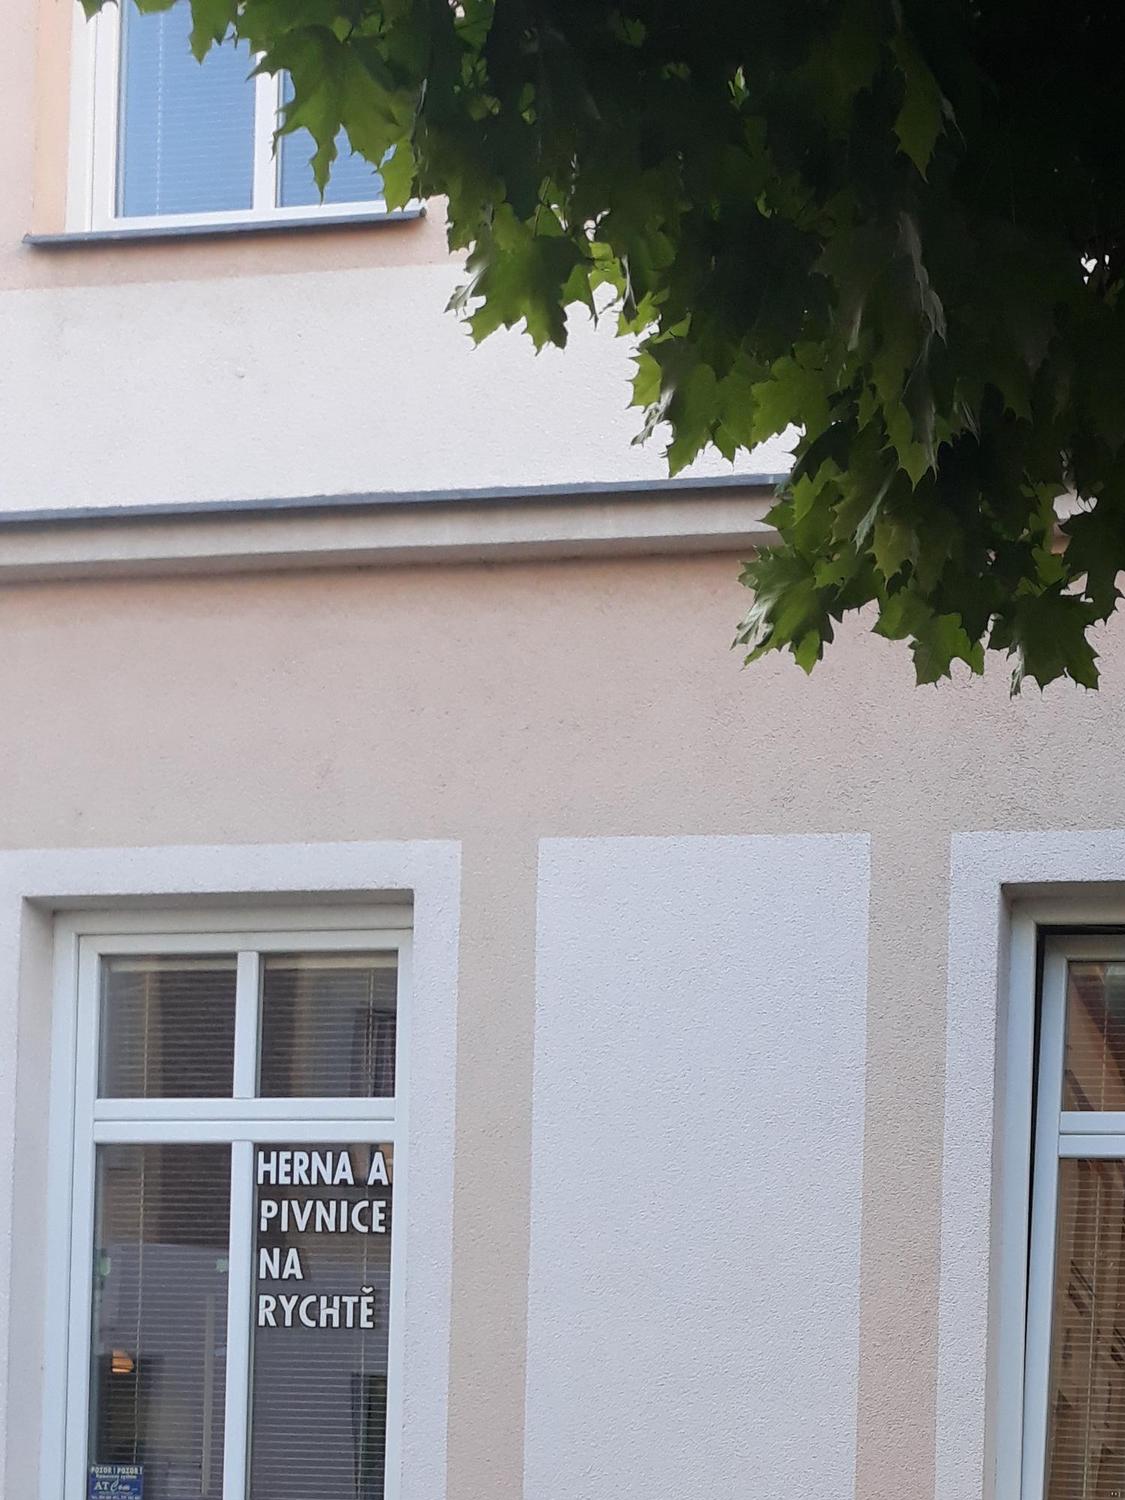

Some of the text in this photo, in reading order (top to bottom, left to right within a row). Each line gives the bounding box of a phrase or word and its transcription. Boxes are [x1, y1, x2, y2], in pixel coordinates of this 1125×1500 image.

[257, 1151, 389, 1185] HERNA A
[260, 1200, 386, 1233] PIVNICE
[259, 1247, 304, 1280] NA
[258, 1285, 375, 1328] RYCHTĚ
